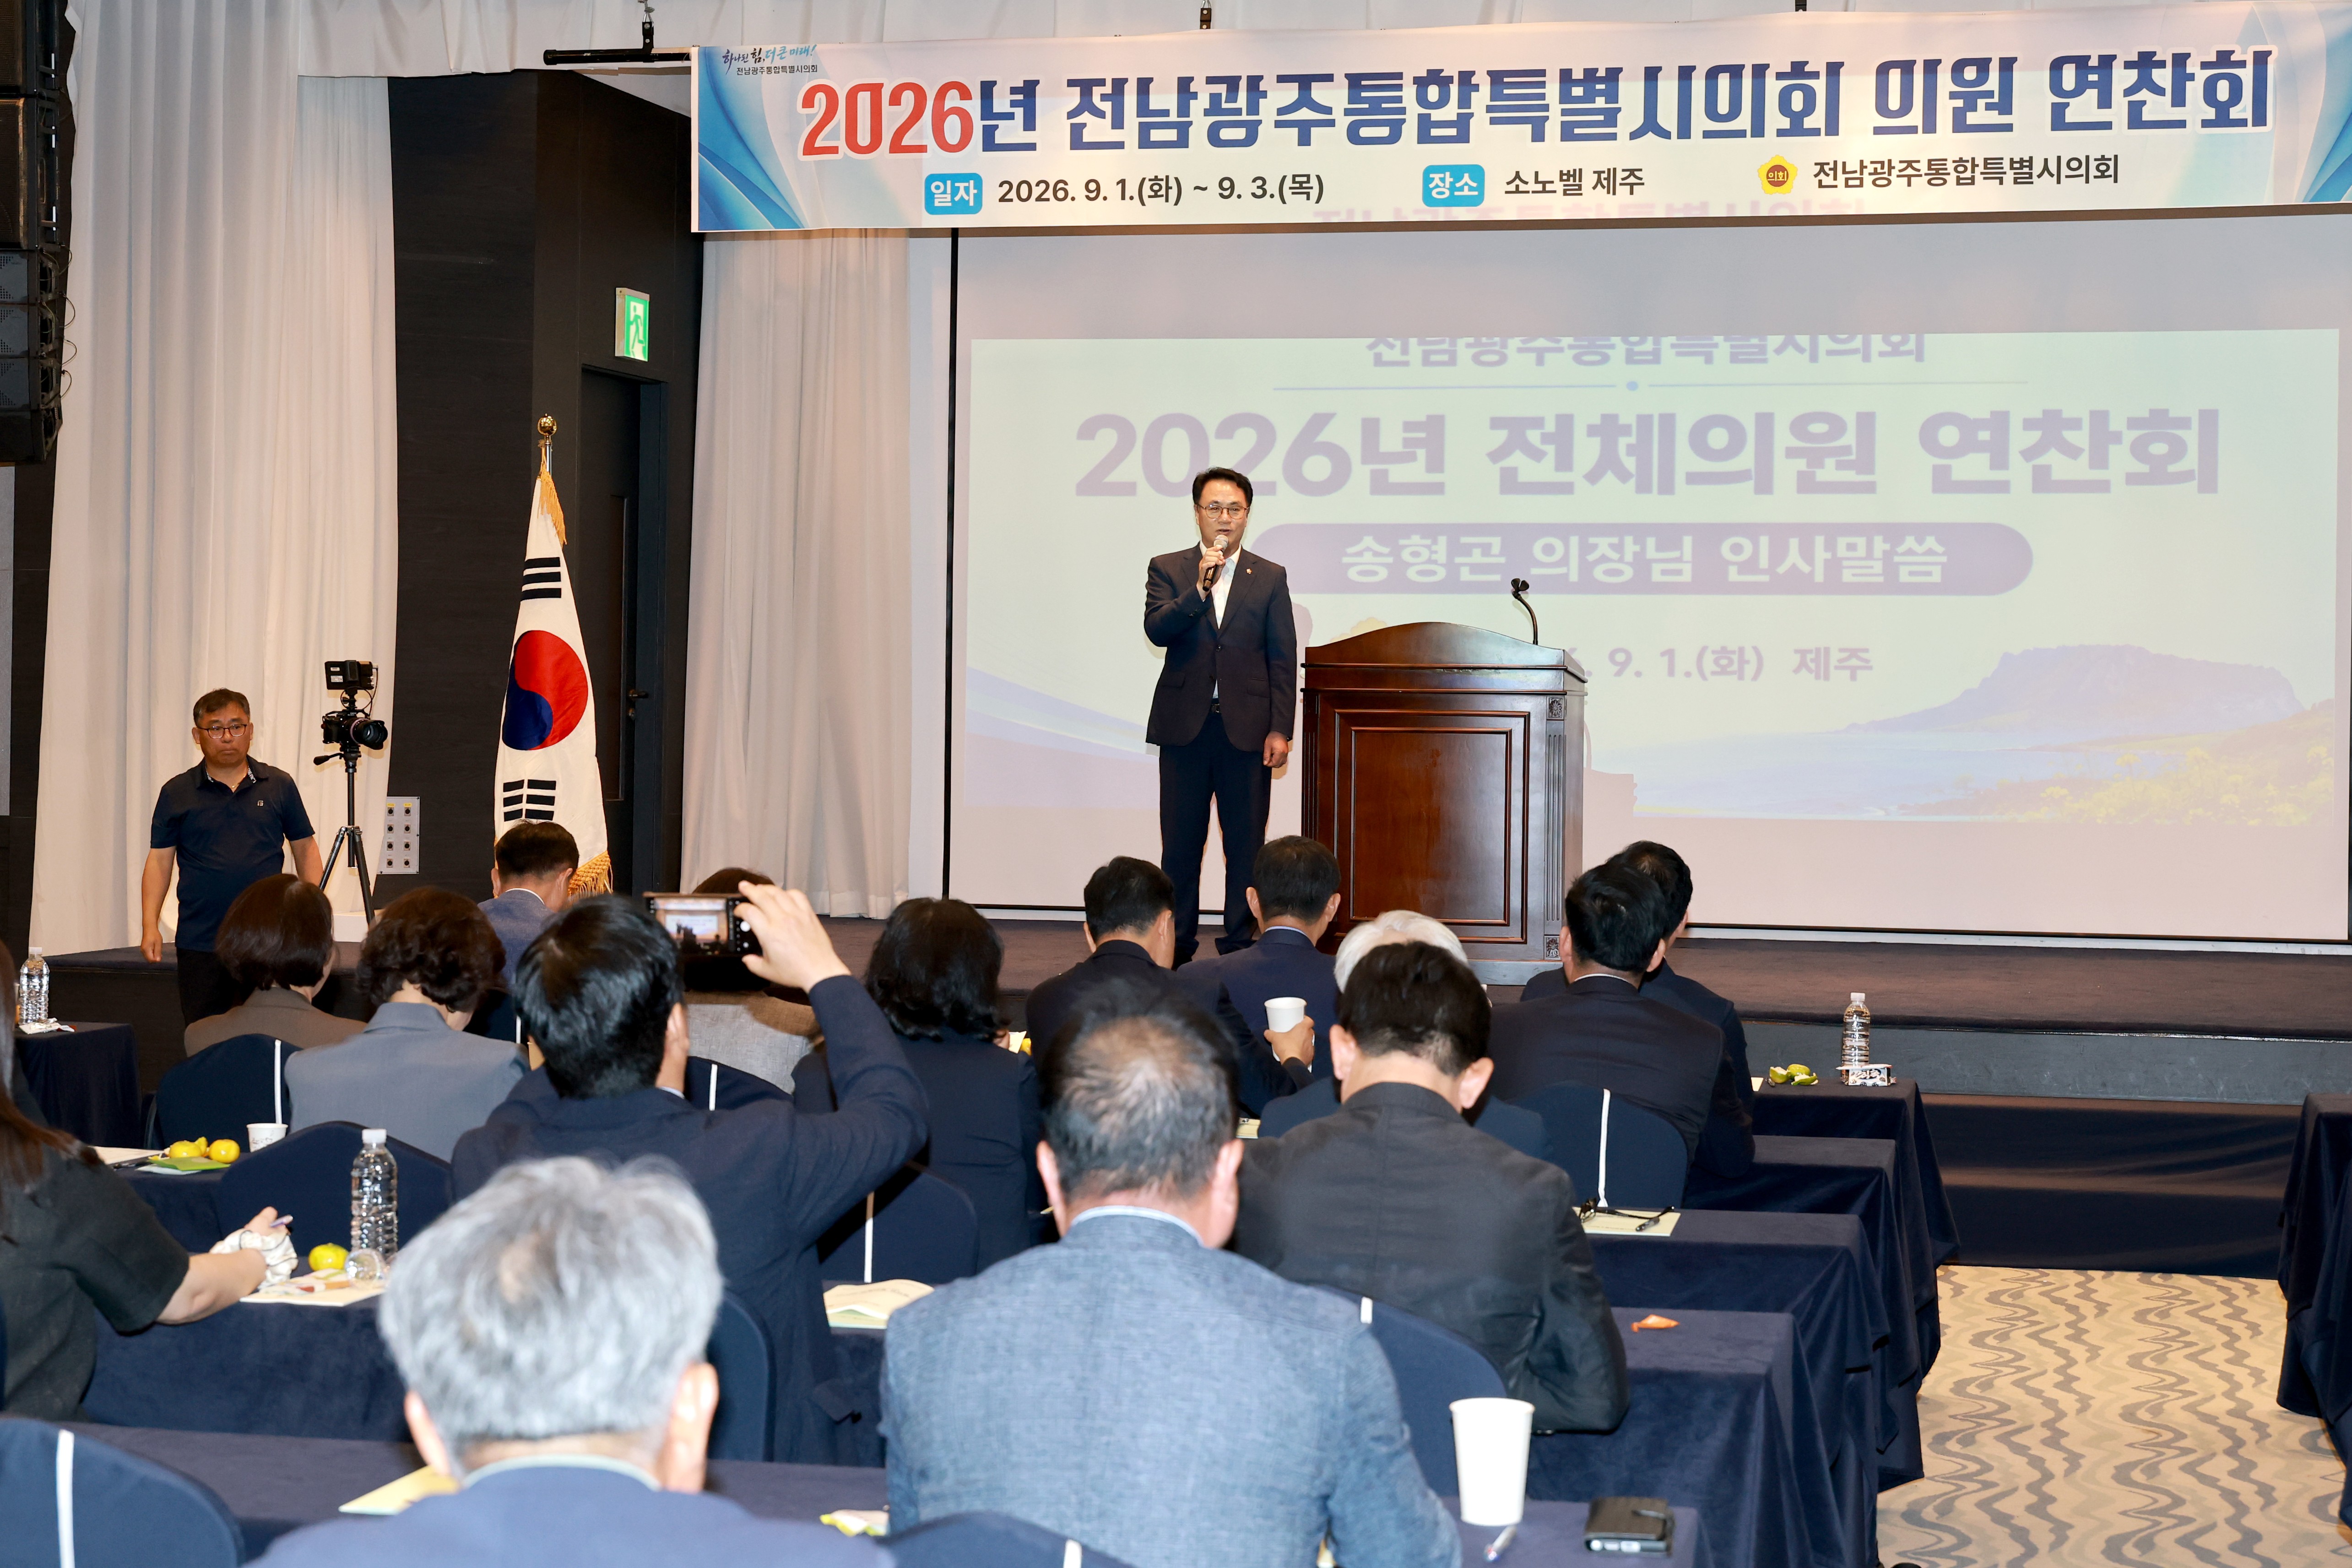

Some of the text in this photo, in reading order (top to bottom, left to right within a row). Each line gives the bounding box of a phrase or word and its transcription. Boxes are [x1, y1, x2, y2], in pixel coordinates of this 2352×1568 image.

[722, 44, 817, 75] 하나된 힘, 더 큰 미래!
[736, 65, 818, 76] 전남광주통합특별시의회
[801, 50, 2273, 156] 2026년 전남광주통합특별시의회 의원 연찬회
[1428, 171, 1479, 199] 장소
[1504, 167, 1645, 197] 소노벨 제주
[1767, 170, 1787, 181] 의회
[1813, 154, 2119, 189] 전남광주통합특별시의회
[931, 180, 978, 207] 일자
[998, 179, 1076, 202] 2026.
[1084, 179, 1108, 201] 9.
[1116, 175, 1182, 206] 1.(화)
[1218, 176, 1242, 200] 9.
[1251, 174, 1324, 205] 3.(목)
[1075, 408, 2219, 497] 2026년 전체의원 연찬회
[1342, 535, 1948, 583] 송형곤 의장님 인사말씀
[1608, 647, 1642, 678] 9.
[1660, 646, 1764, 682] 1.(화)
[1792, 646, 1873, 682] 제주
